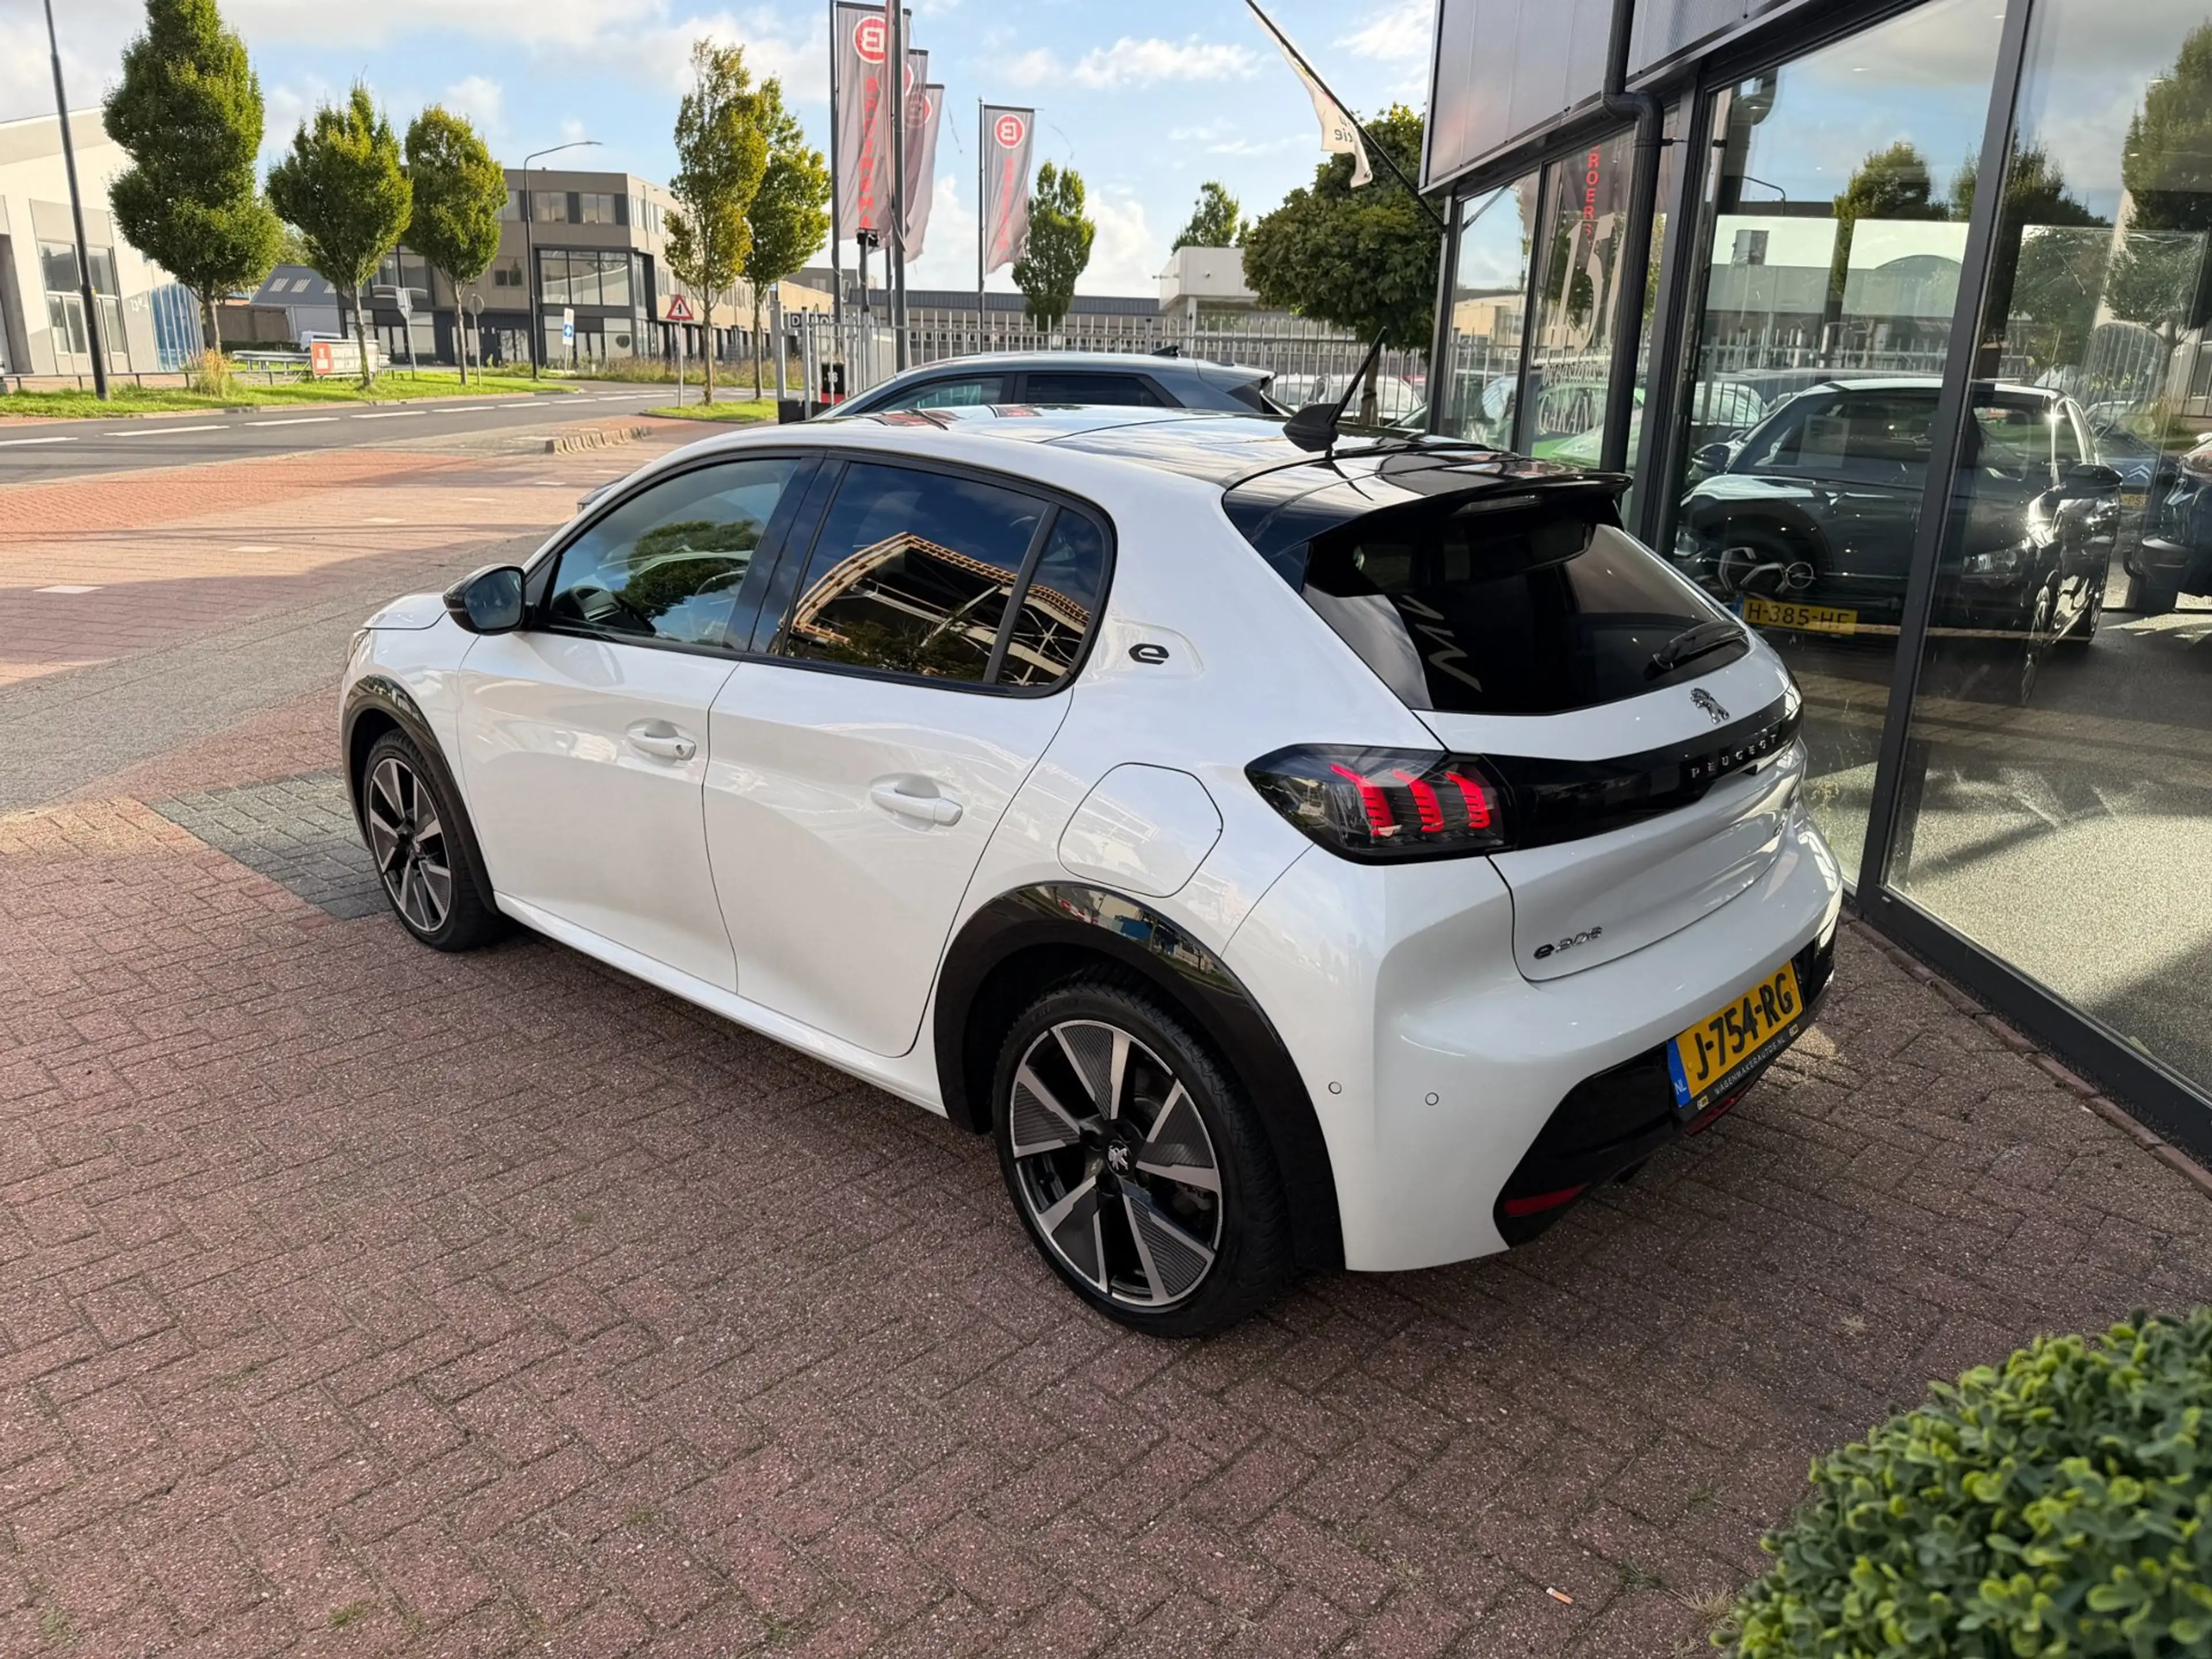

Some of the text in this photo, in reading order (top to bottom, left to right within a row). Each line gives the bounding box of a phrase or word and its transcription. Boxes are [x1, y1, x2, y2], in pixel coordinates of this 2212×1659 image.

[1691, 733, 1776, 778] PEUGEOT
[1695, 973, 1794, 1081] J-754-RG
[1673, 1078, 1687, 1095] NL
